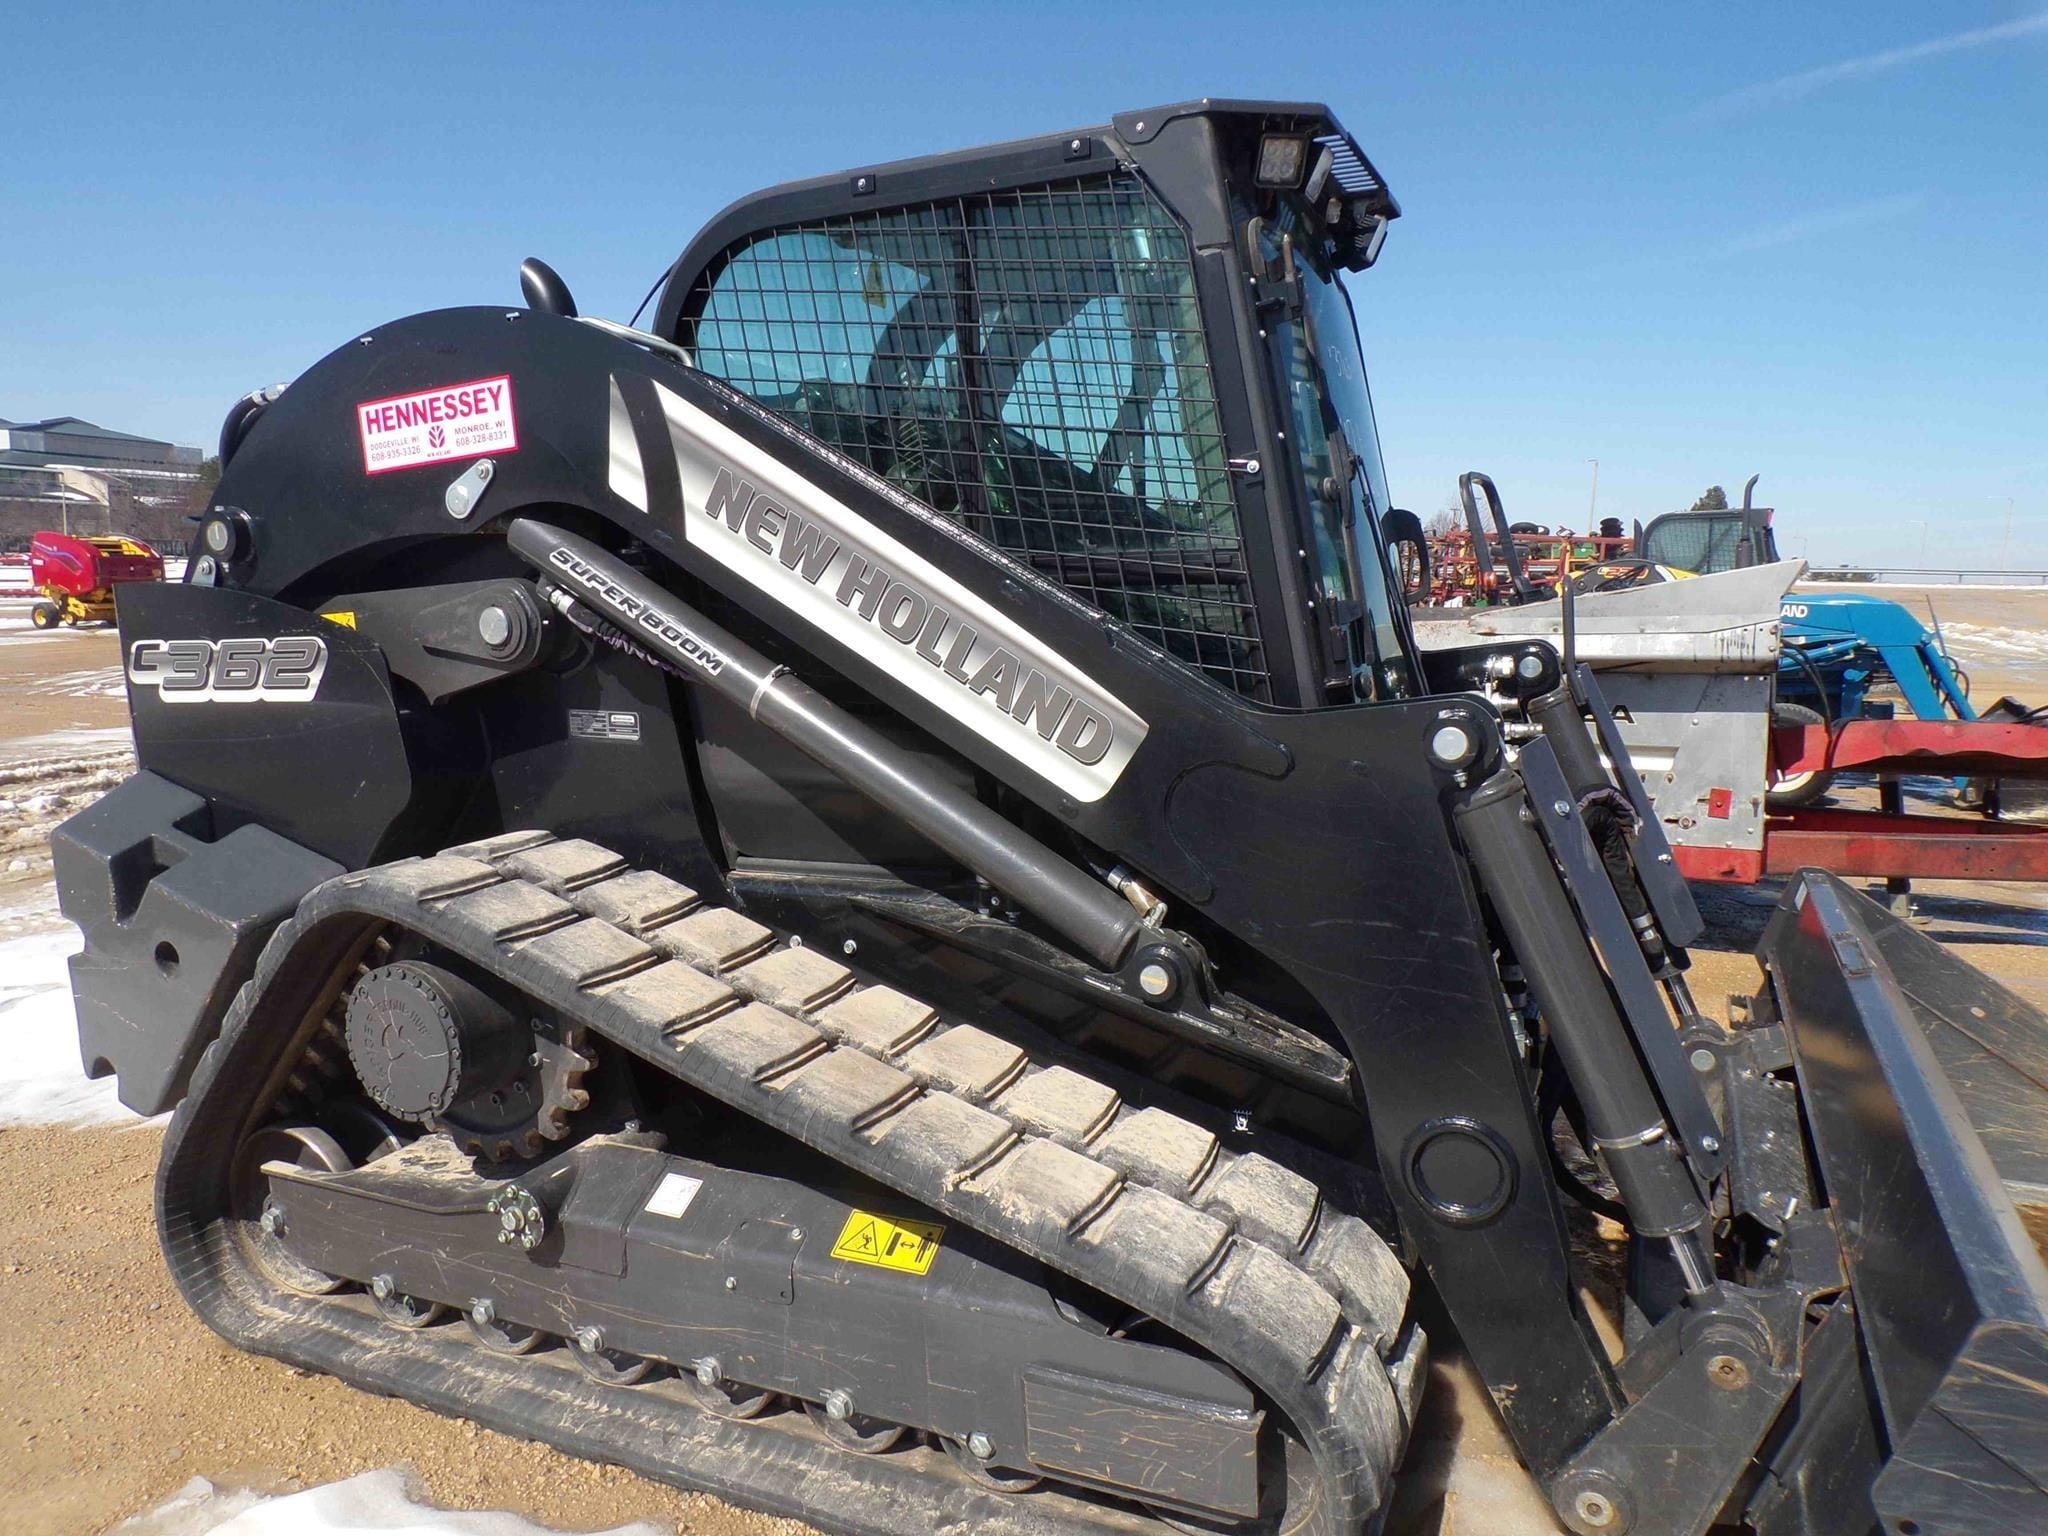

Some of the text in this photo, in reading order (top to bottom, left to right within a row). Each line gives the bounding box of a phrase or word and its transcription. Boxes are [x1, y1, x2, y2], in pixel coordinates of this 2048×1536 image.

[366, 385, 502, 435] HENNESSEY
[550, 548, 726, 676] SUPER BOOM
[704, 466, 1114, 766] NEW HOLLAND
